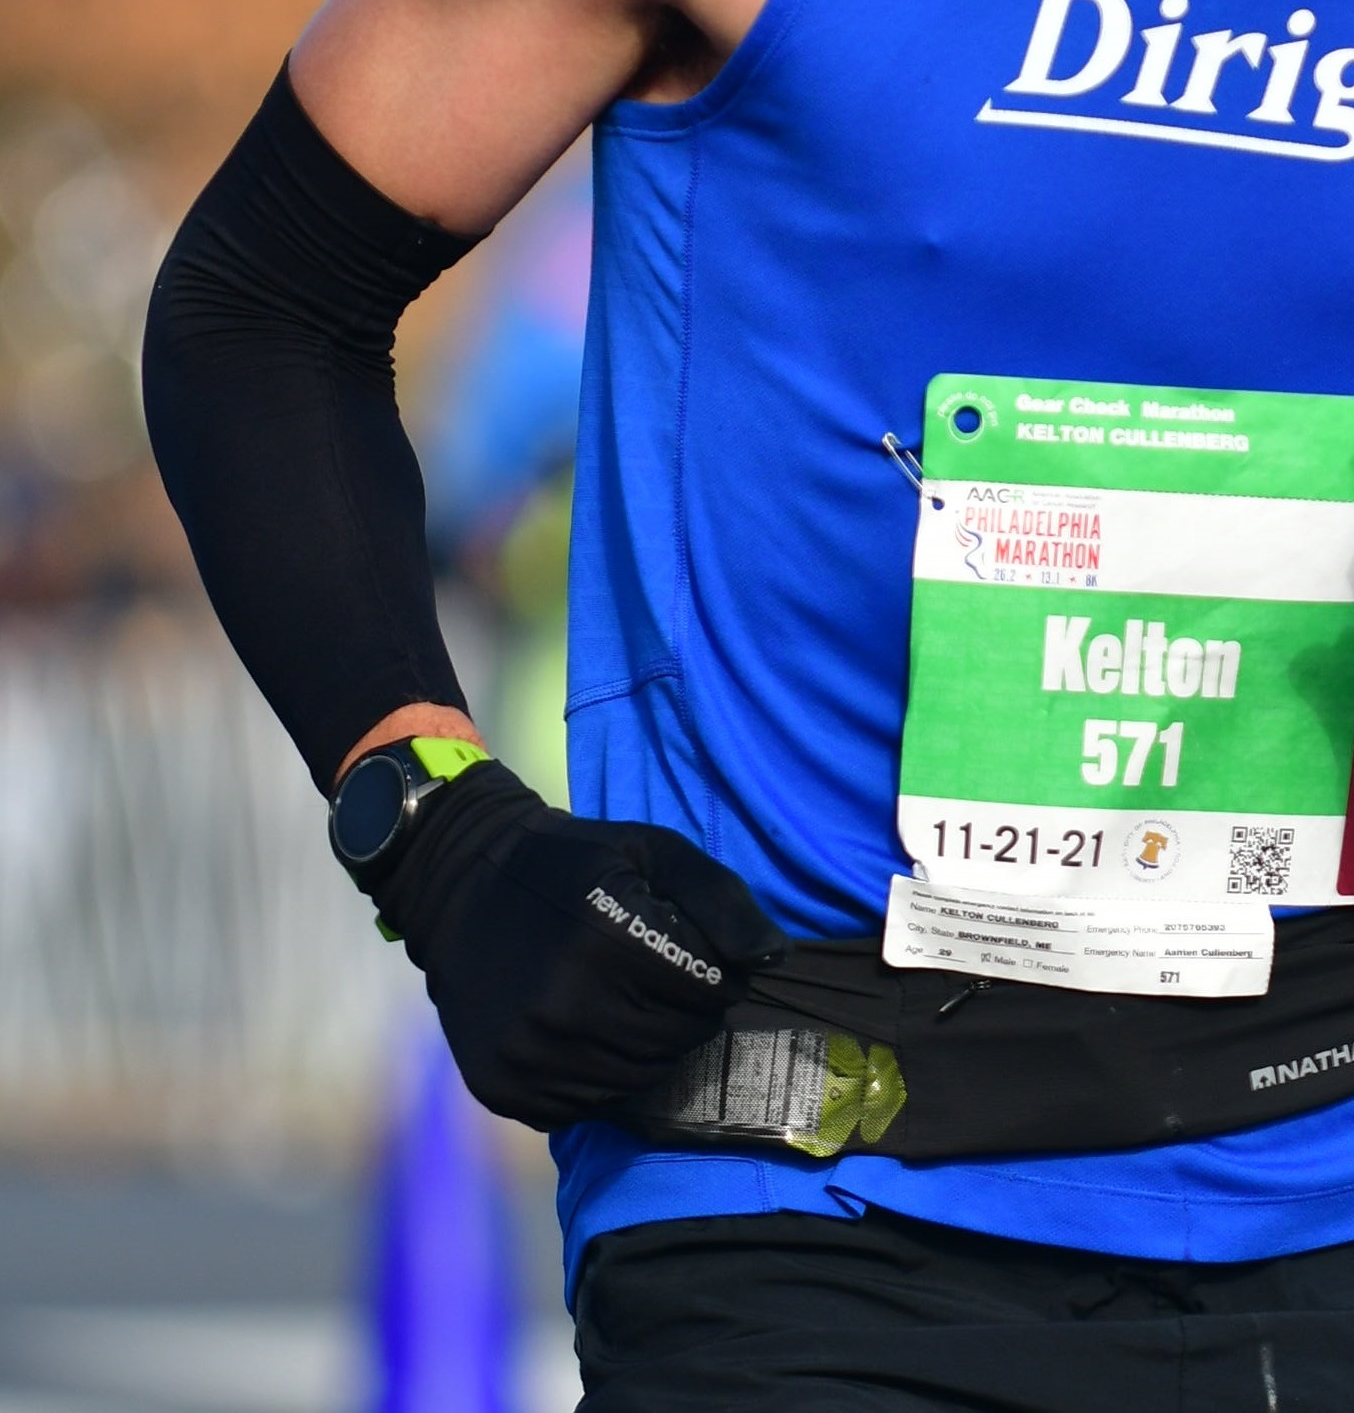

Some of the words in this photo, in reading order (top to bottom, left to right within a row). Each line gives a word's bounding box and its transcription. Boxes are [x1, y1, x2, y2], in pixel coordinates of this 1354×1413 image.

[1016, 393, 1065, 413] Gear
[1069, 396, 1131, 417] Check
[1141, 400, 1236, 422] Marathon
[1016, 422, 1105, 444] KELTON
[1110, 428, 1249, 452] CULLENBERG
[966, 486, 1025, 504] AACR
[964, 506, 1101, 539] PHILADELPHIA
[994, 538, 1101, 570] MARATHON
[993, 568, 1016, 582] 26.2
[1041, 571, 1060, 585] 13.1
[1085, 574, 1098, 587] 8K
[1041, 614, 1242, 699] Kelton
[1080, 719, 1185, 787] 571
[933, 819, 1104, 867] 11-21-21
[910, 901, 937, 915] Name
[940, 906, 985, 921] KELTON
[986, 913, 1060, 929] CULLENBERG
[586, 886, 631, 923] new
[627, 914, 722, 985] balance
[931, 926, 955, 939] State
[1035, 941, 1053, 950] ME
[905, 943, 923, 956] Age
[994, 954, 1017, 966] Male
[1036, 961, 1070, 974] Female
[1084, 947, 1129, 959] Emergency
[1159, 971, 1181, 984] 571
